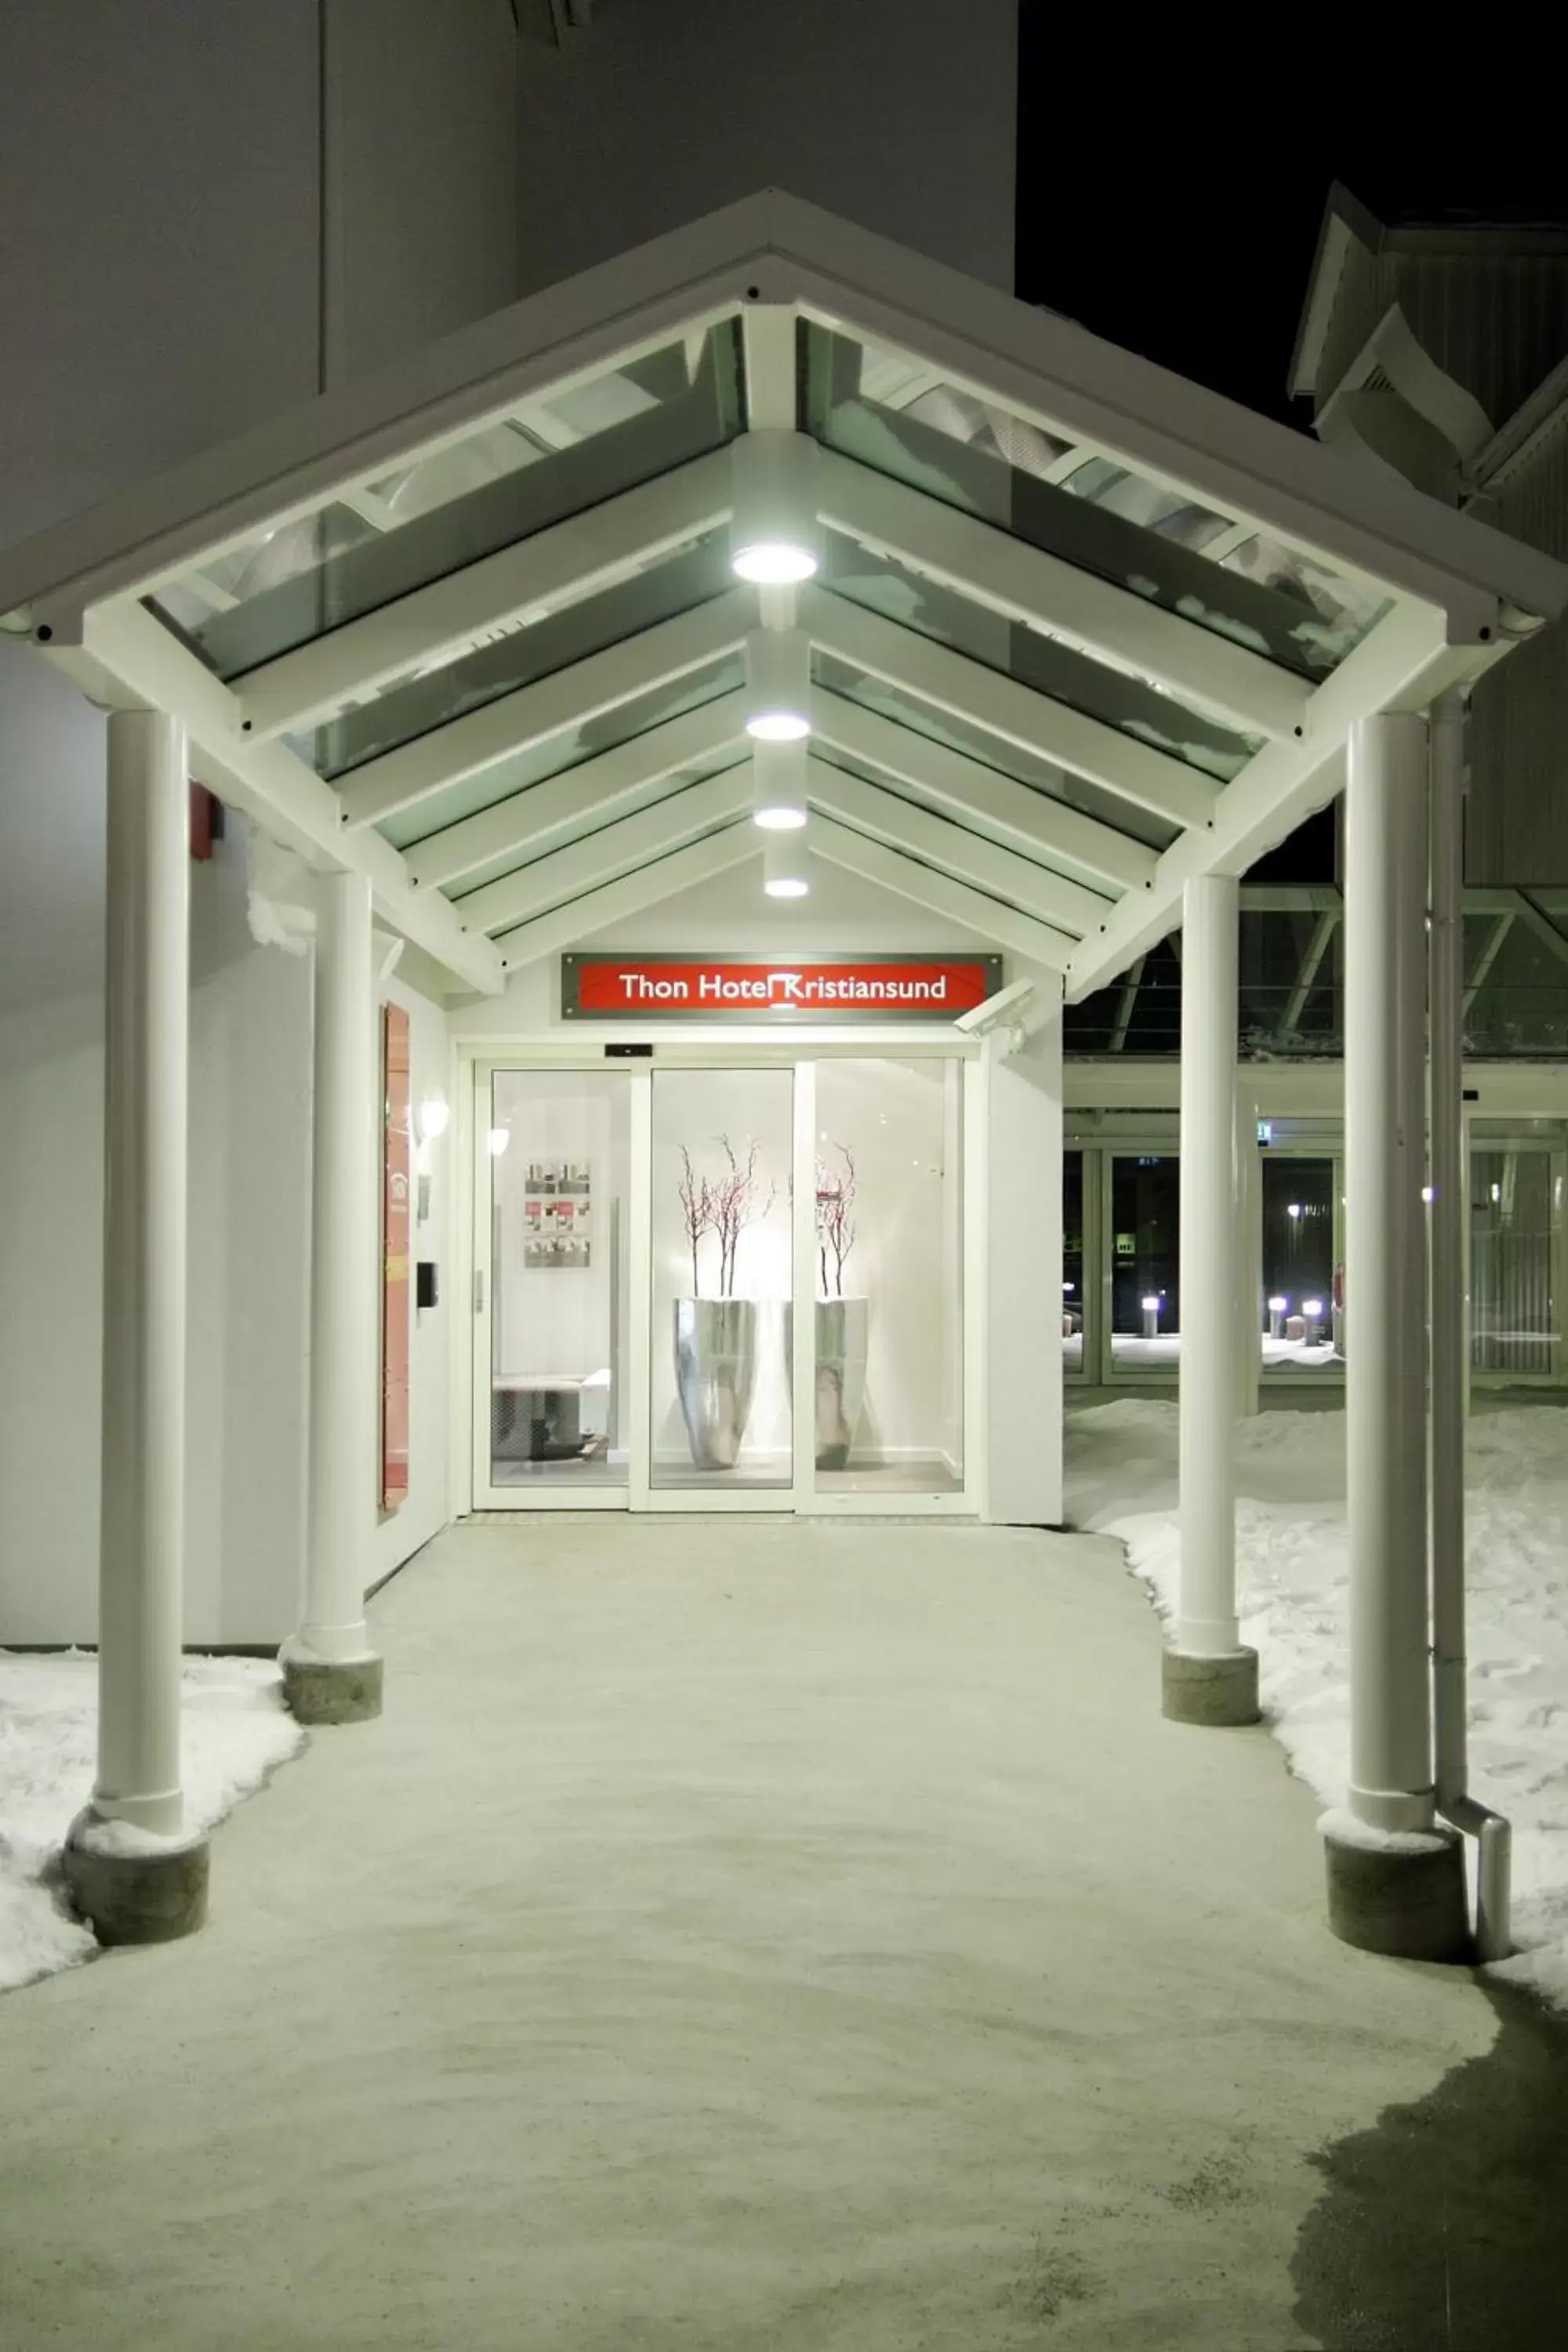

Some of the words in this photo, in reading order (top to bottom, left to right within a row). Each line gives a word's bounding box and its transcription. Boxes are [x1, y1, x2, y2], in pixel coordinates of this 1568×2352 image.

[619, 974, 688, 999] Thon
[699, 974, 774, 999] Hotel
[785, 974, 946, 999] Kristiansund
